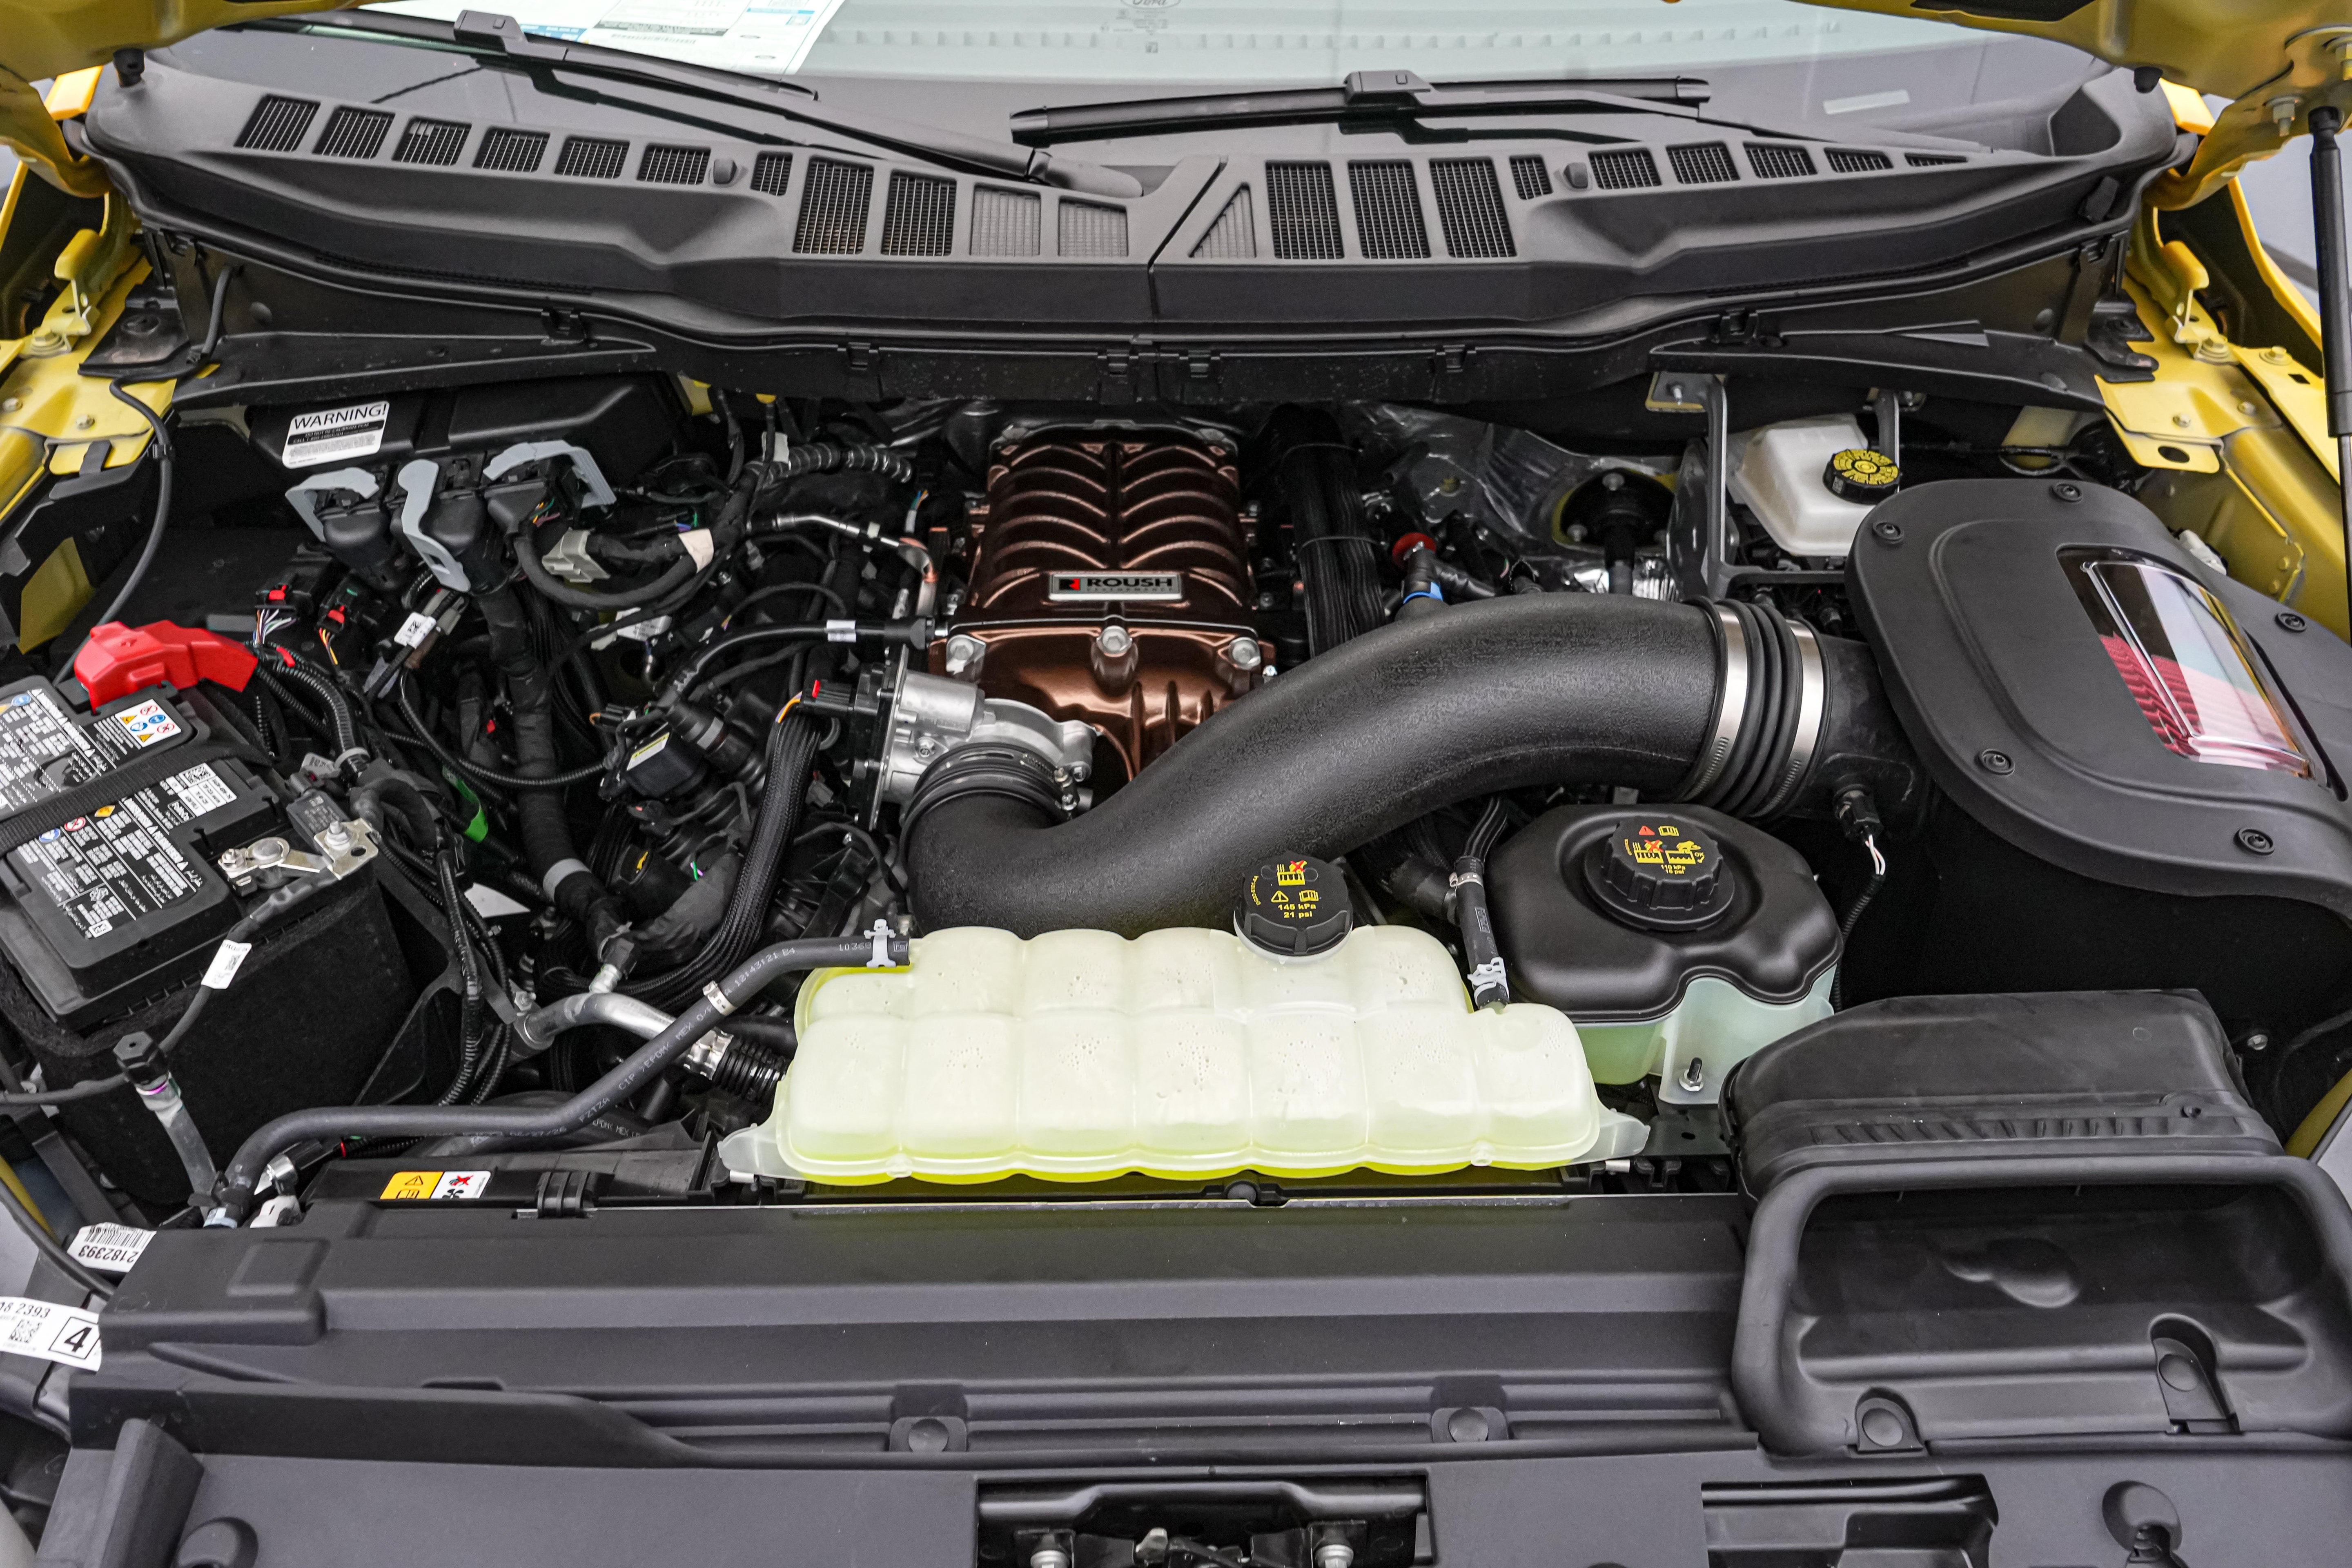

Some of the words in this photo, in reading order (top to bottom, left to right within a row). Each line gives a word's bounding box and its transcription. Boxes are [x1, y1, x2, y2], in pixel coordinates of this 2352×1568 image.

[295, 403, 387, 430] WARNING!
[1087, 578, 1172, 587] ROUSH
[1298, 911, 1312, 919] psi
[78, 1245, 139, 1263] 2182393
[16, 1303, 51, 1319] 2393
[64, 1327, 92, 1352] 4
